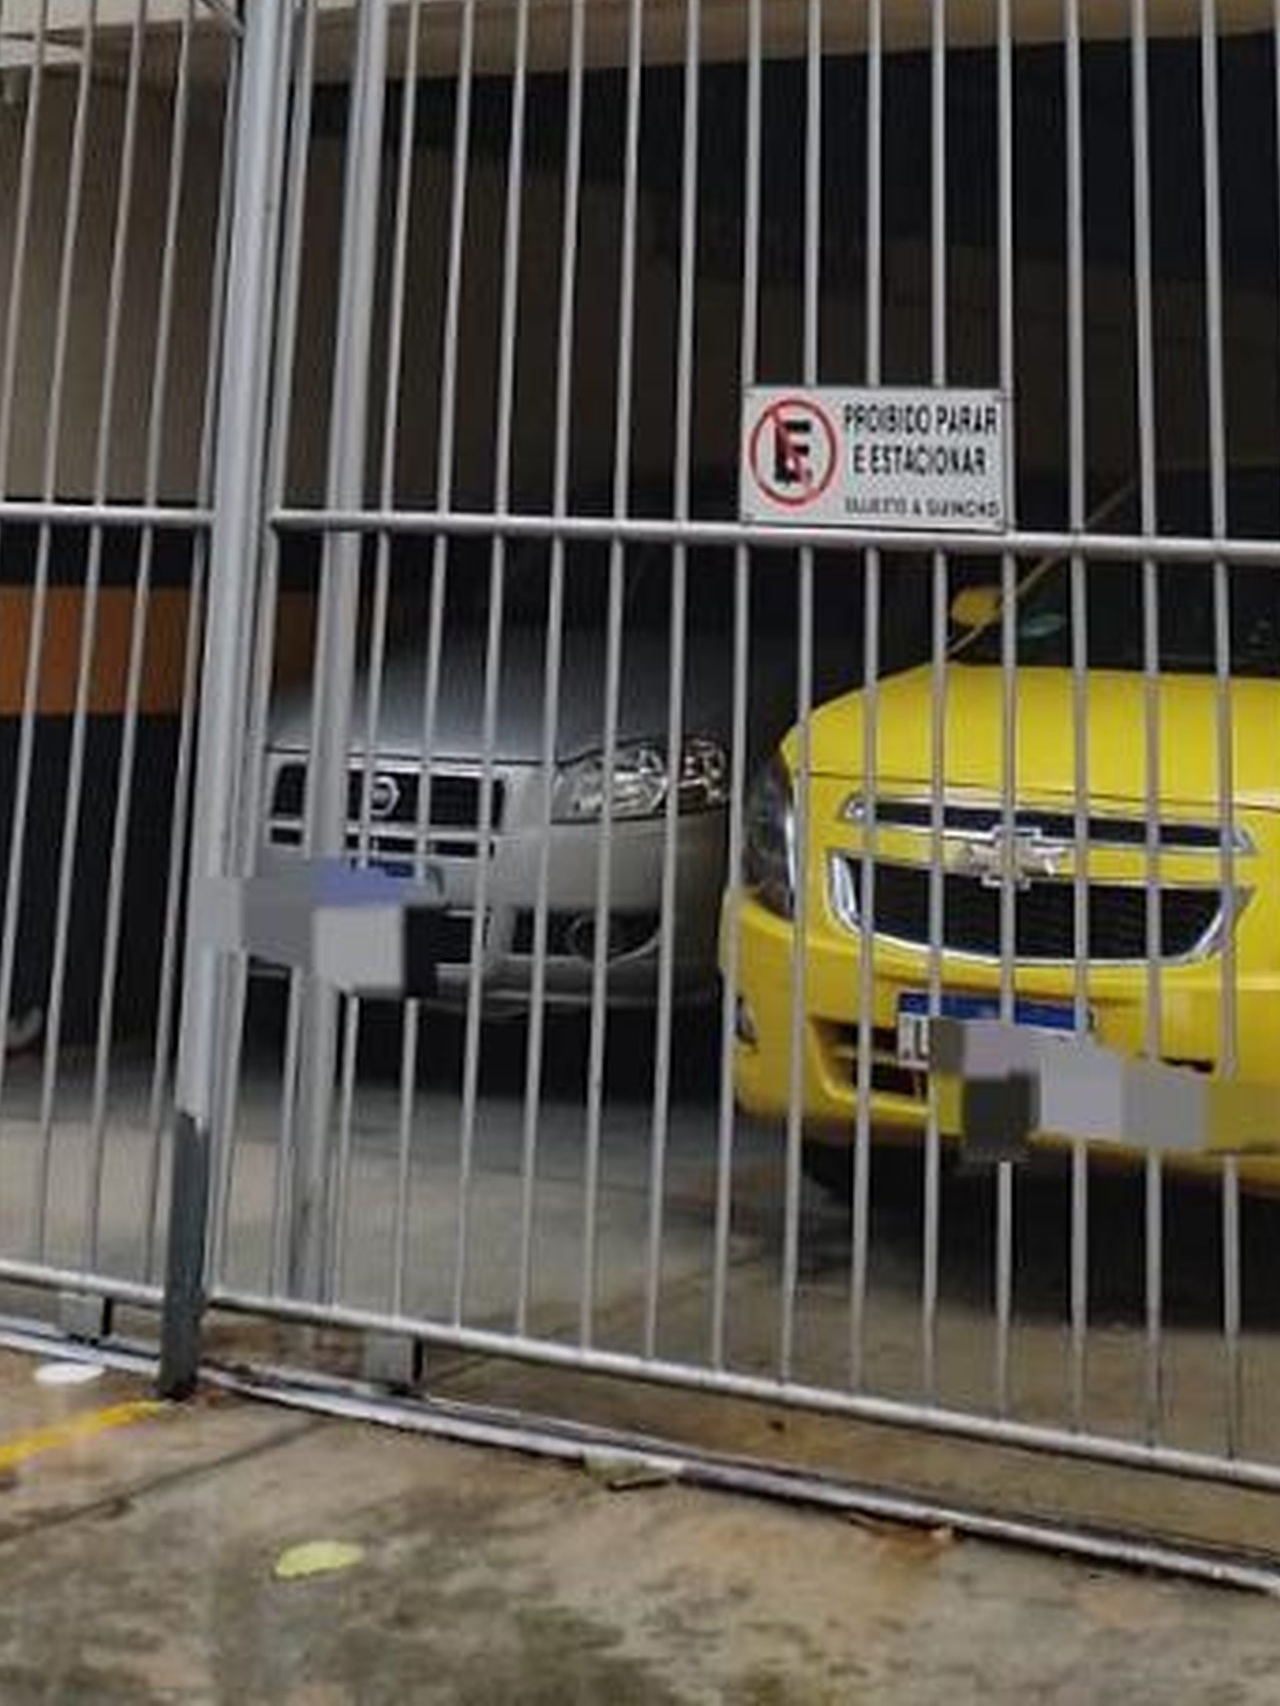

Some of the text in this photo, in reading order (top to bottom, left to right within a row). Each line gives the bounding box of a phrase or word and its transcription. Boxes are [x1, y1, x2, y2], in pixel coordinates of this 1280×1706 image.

[844, 403, 998, 436] PROIBIDO PARAR
[853, 444, 987, 476] E ESTACIONAR
